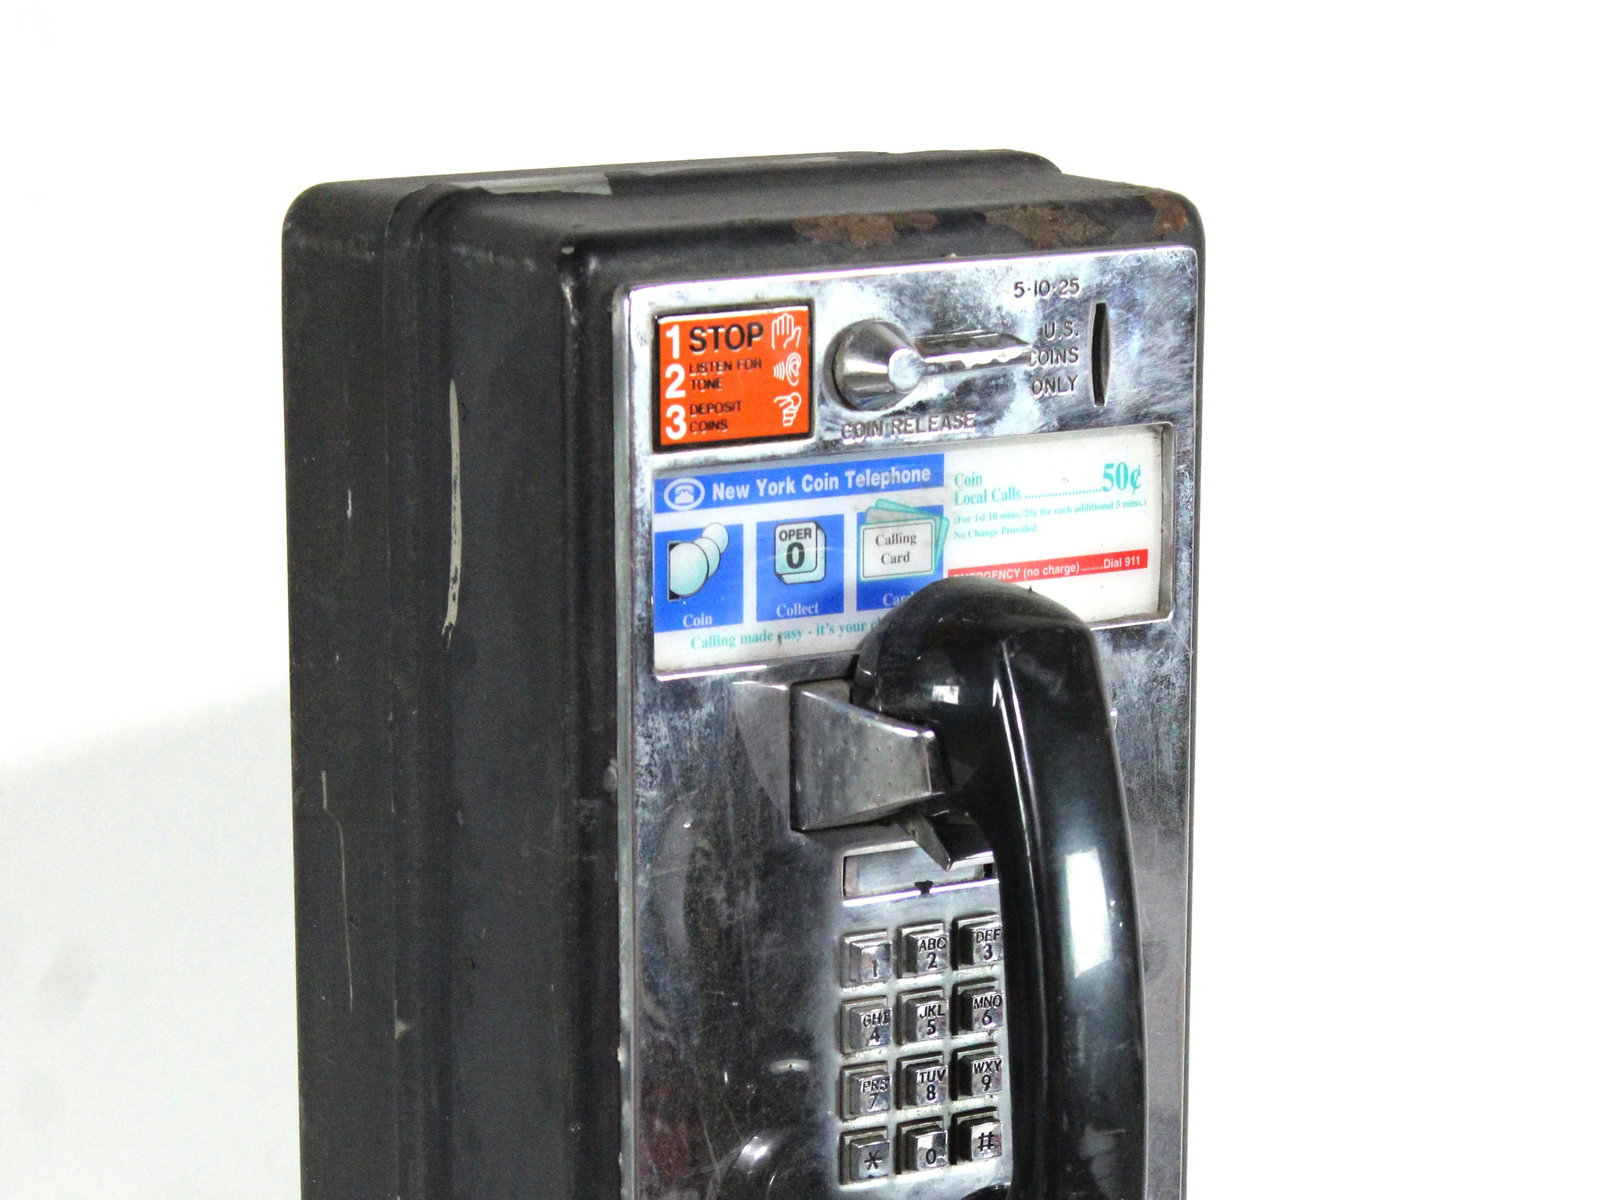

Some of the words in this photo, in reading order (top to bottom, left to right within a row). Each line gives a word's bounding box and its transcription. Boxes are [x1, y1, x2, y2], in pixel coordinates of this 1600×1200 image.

[689, 322, 764, 354] STOP
[1043, 321, 1079, 341] U.S.
[665, 323, 680, 359] 1
[689, 360, 733, 377] LISTEN
[737, 357, 763, 372] FOR
[665, 363, 687, 399] 2
[690, 378, 723, 392] TONE
[1031, 374, 1079, 396] ONLY
[689, 400, 742, 417] DEPOSIT
[665, 404, 688, 440] 3
[689, 420, 728, 435] COINS
[841, 420, 884, 442] COIN
[890, 413, 976, 436] RELEASE
[712, 482, 750, 501] New
[756, 475, 797, 496] York
[801, 471, 839, 492] Coin
[845, 465, 932, 492] Telephone
[954, 472, 983, 487] Coin
[954, 488, 988, 506] Local
[991, 486, 1021, 502] Calls
[1102, 461, 1142, 495] 50¢
[1040, 506, 1052, 516] for
[1054, 505, 1072, 515] each
[1074, 501, 1114, 514] additional
[1116, 500, 1121, 509] 5
[778, 527, 812, 542] OPER
[954, 530, 966, 540] No
[968, 527, 999, 539] Change
[1001, 523, 1037, 536] Provided
[875, 532, 917, 549] Calling
[786, 541, 806, 570] 0
[880, 551, 911, 565] Card
[1023, 567, 1040, 580] (no
[1043, 562, 1080, 577] charge)
[1103, 558, 1122, 570] Dial
[1125, 555, 1141, 567] 911
[682, 613, 713, 628] Coin
[776, 602, 819, 618] Collect
[690, 632, 737, 650] Calling
[740, 627, 774, 644] made
[778, 627, 804, 645] easy
[838, 621, 867, 637] your
[976, 928, 1001, 943] DEF
[919, 937, 947, 953] ABC
[983, 944, 993, 961] 3
[872, 960, 879, 978] 1
[926, 951, 938, 970] 2
[974, 994, 1003, 1010] MNO
[919, 1003, 946, 1019] JKL
[981, 1009, 993, 1026] 6
[869, 1027, 881, 1043] 4
[926, 1018, 936, 1036] 5
[973, 1060, 1002, 1075] WXY
[919, 1069, 946, 1084] TUV
[981, 1075, 992, 1092] 9
[862, 1079, 889, 1094] PRS
[926, 1084, 936, 1102] 8
[869, 1093, 879, 1110] 7
[978, 1131, 995, 1152] #
[925, 1148, 937, 1165] 0
